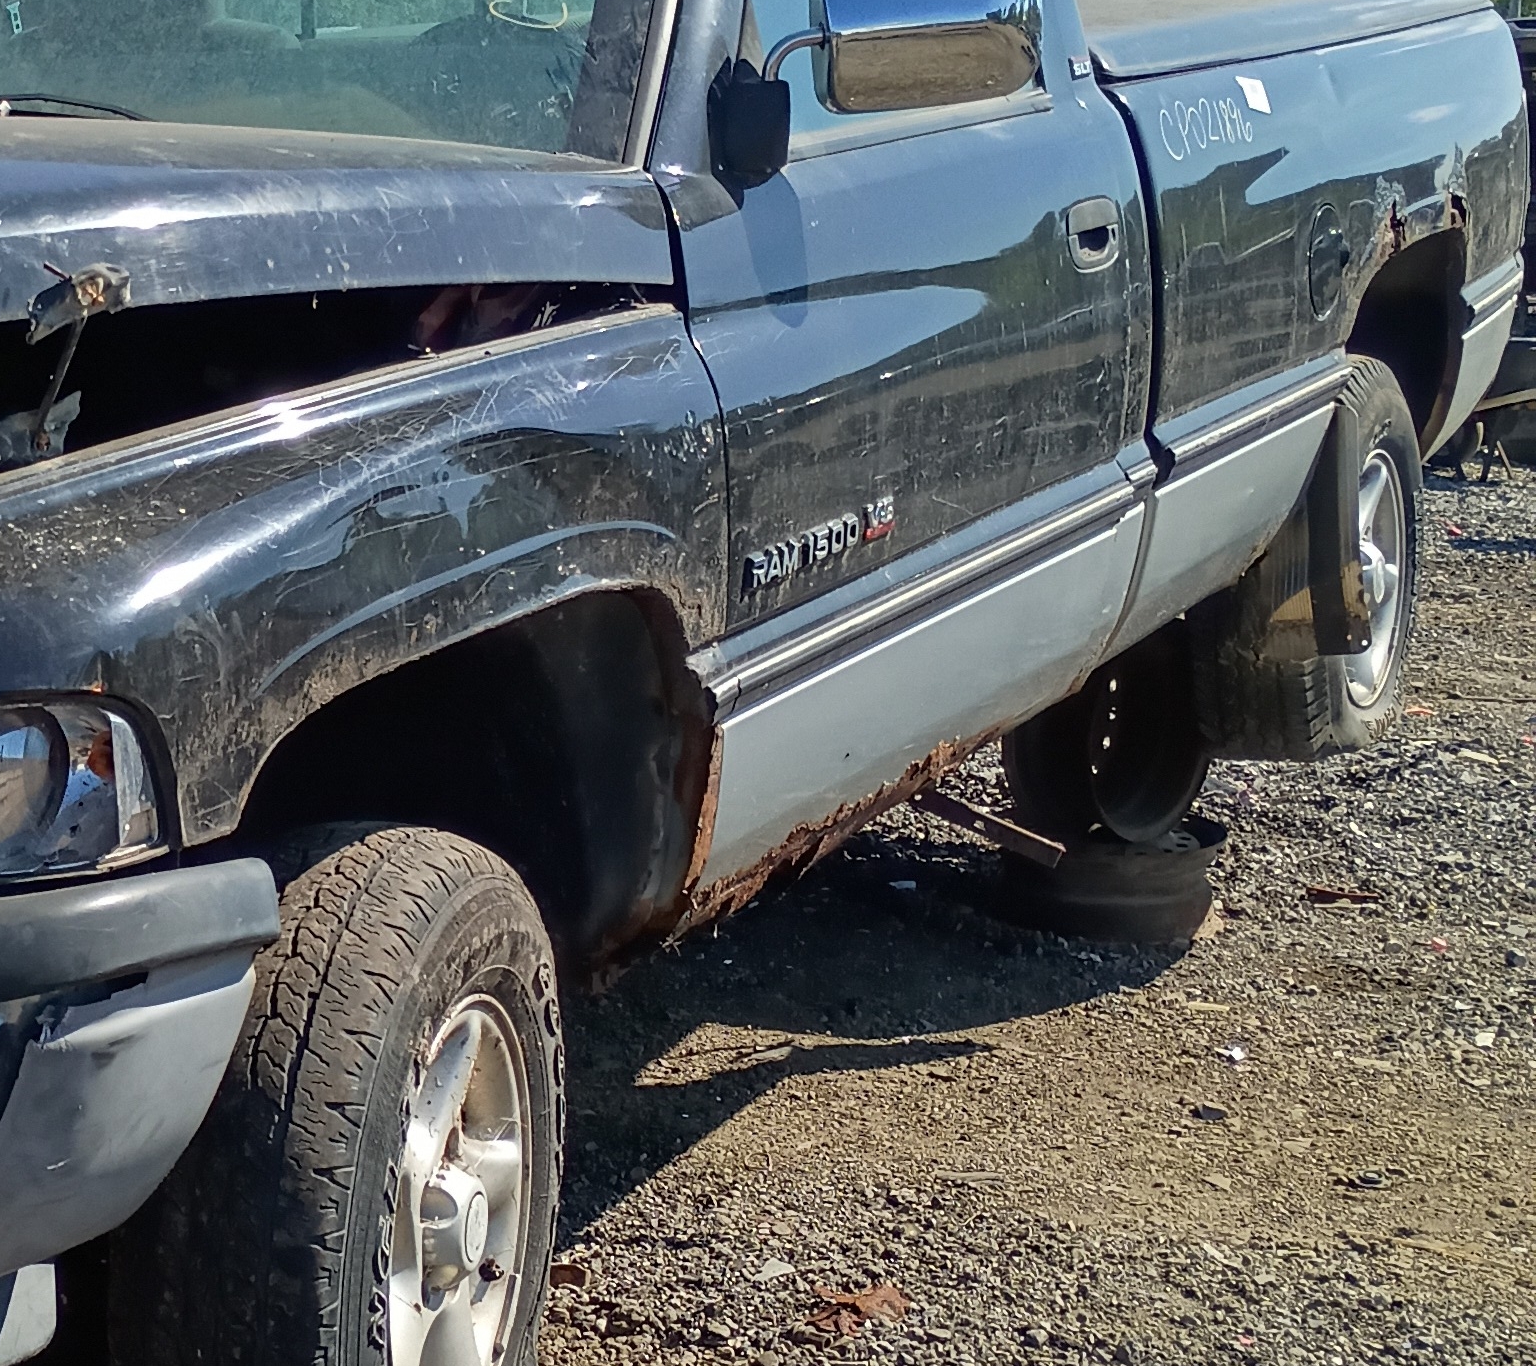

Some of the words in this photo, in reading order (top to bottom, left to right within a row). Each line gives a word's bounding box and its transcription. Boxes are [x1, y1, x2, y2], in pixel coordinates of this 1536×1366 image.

[1159, 97, 1253, 161] CP021896
[745, 538, 802, 589] RAM
[800, 512, 859, 564] 1500
